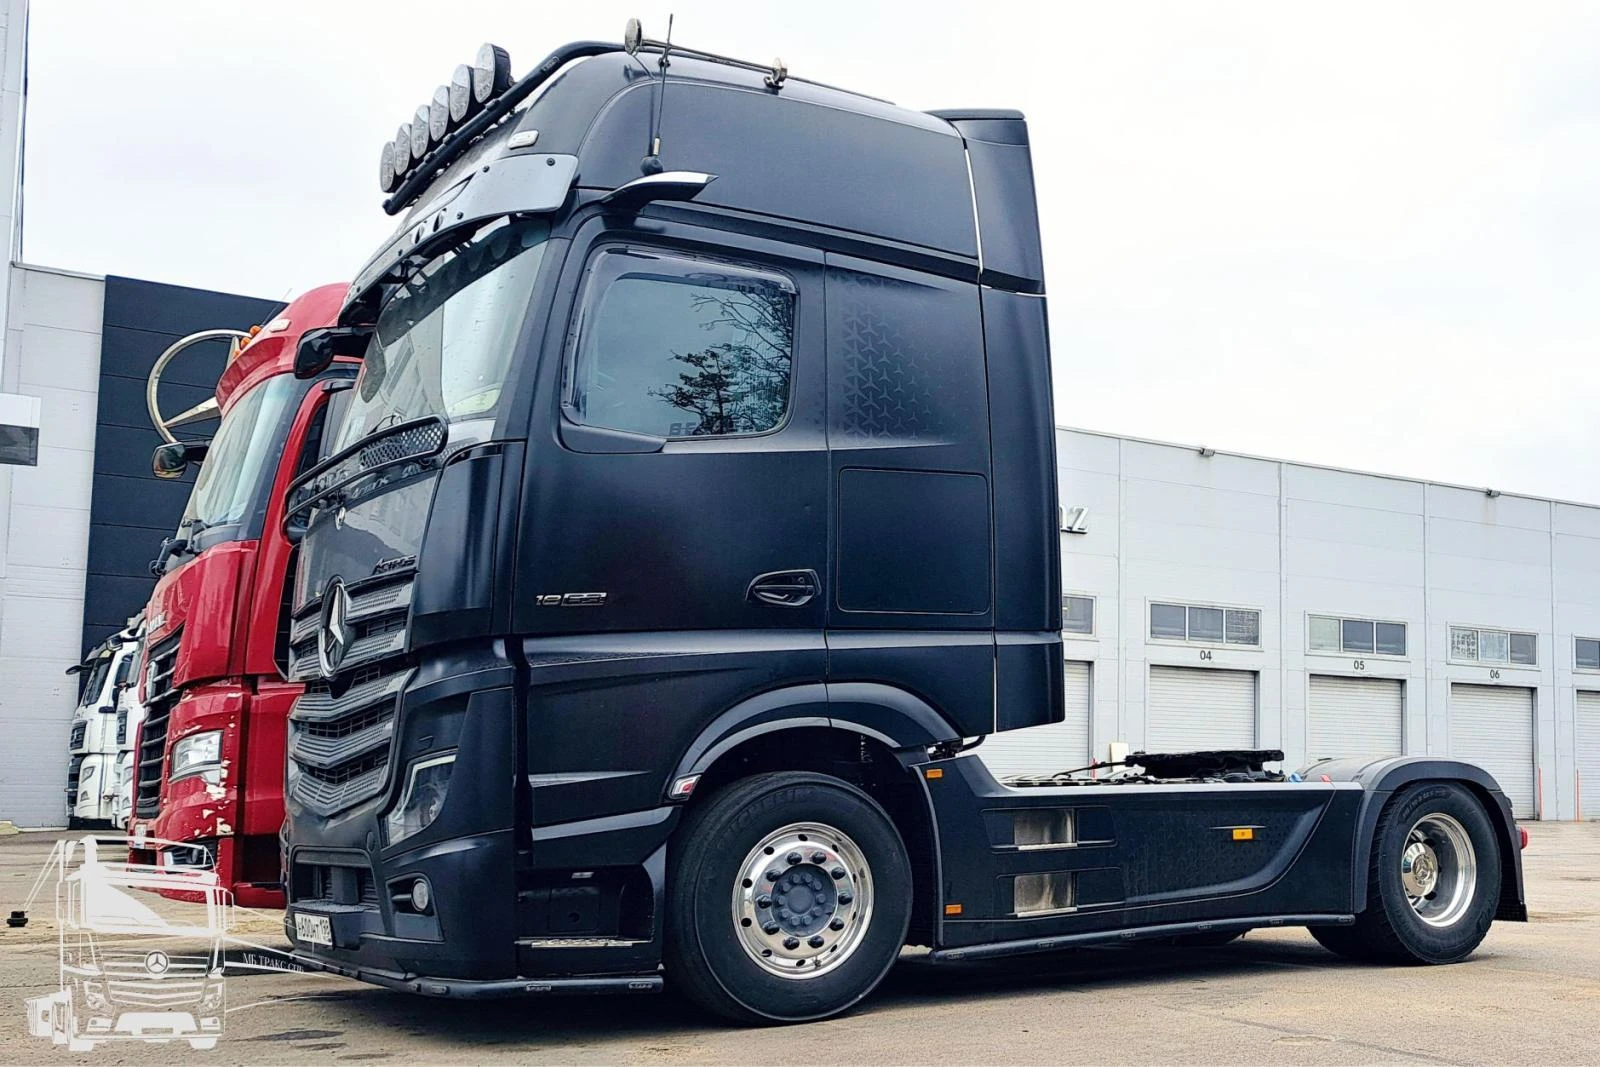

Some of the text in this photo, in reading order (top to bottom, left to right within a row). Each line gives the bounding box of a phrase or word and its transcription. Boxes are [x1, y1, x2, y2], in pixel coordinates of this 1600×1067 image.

[1199, 649, 1212, 661] 04
[1353, 660, 1365, 670] 05
[1489, 669, 1500, 679] 06
